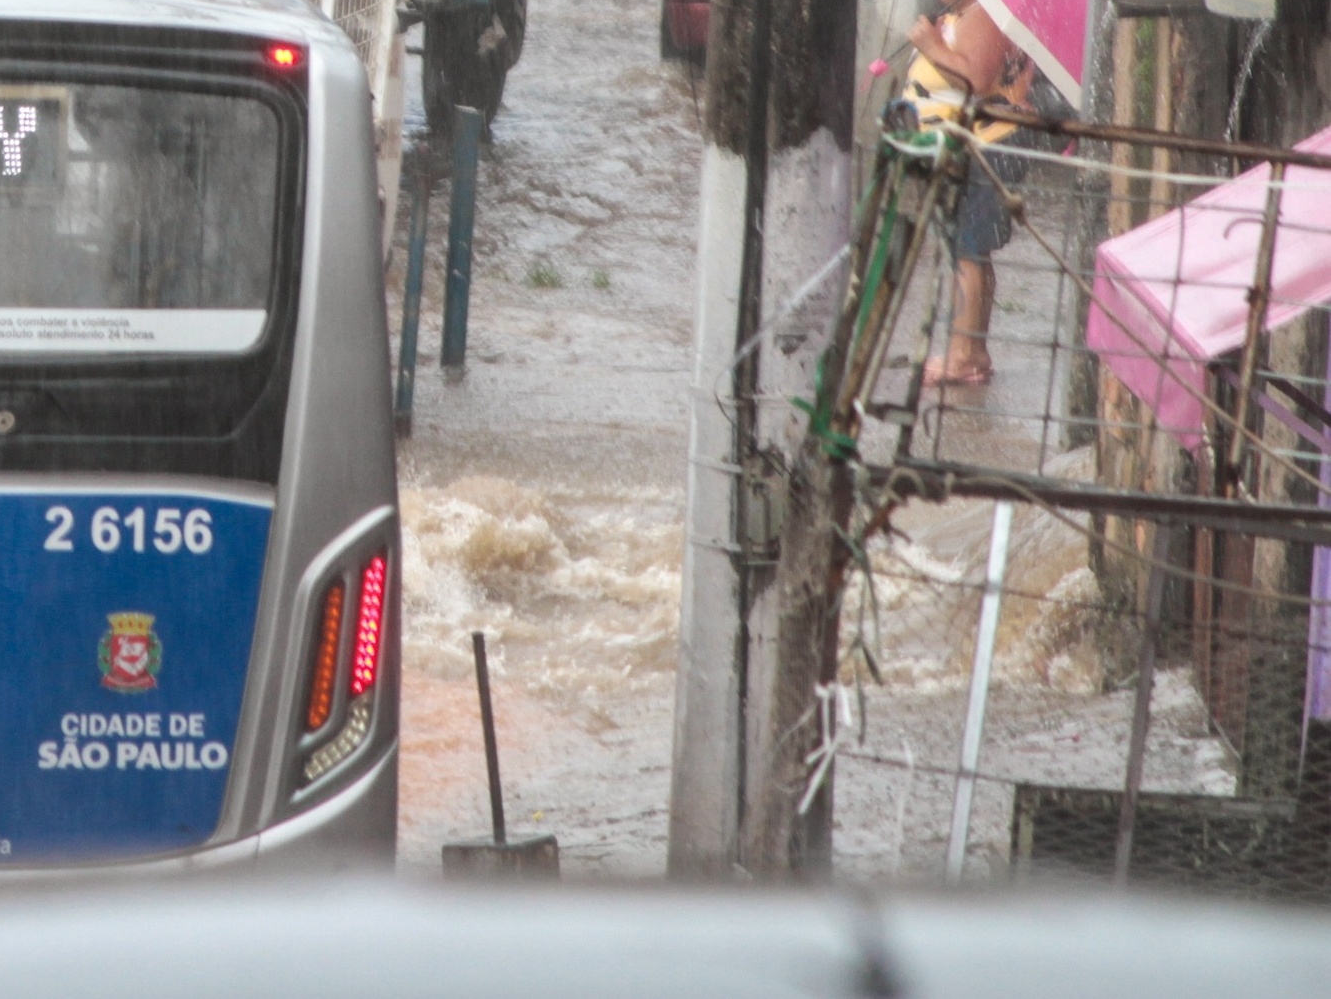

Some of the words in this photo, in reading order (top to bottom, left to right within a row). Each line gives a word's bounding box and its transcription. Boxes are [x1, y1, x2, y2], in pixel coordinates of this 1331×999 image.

[17, 315, 68, 328] combater
[108, 328, 120, 340] 24
[123, 328, 155, 341] horas
[43, 506, 75, 551] 2
[90, 506, 214, 554] 6156
[61, 713, 161, 737] CIDADE
[169, 714, 205, 737] DE
[37, 738, 110, 769] SÃO
[116, 741, 228, 770] PAULO
